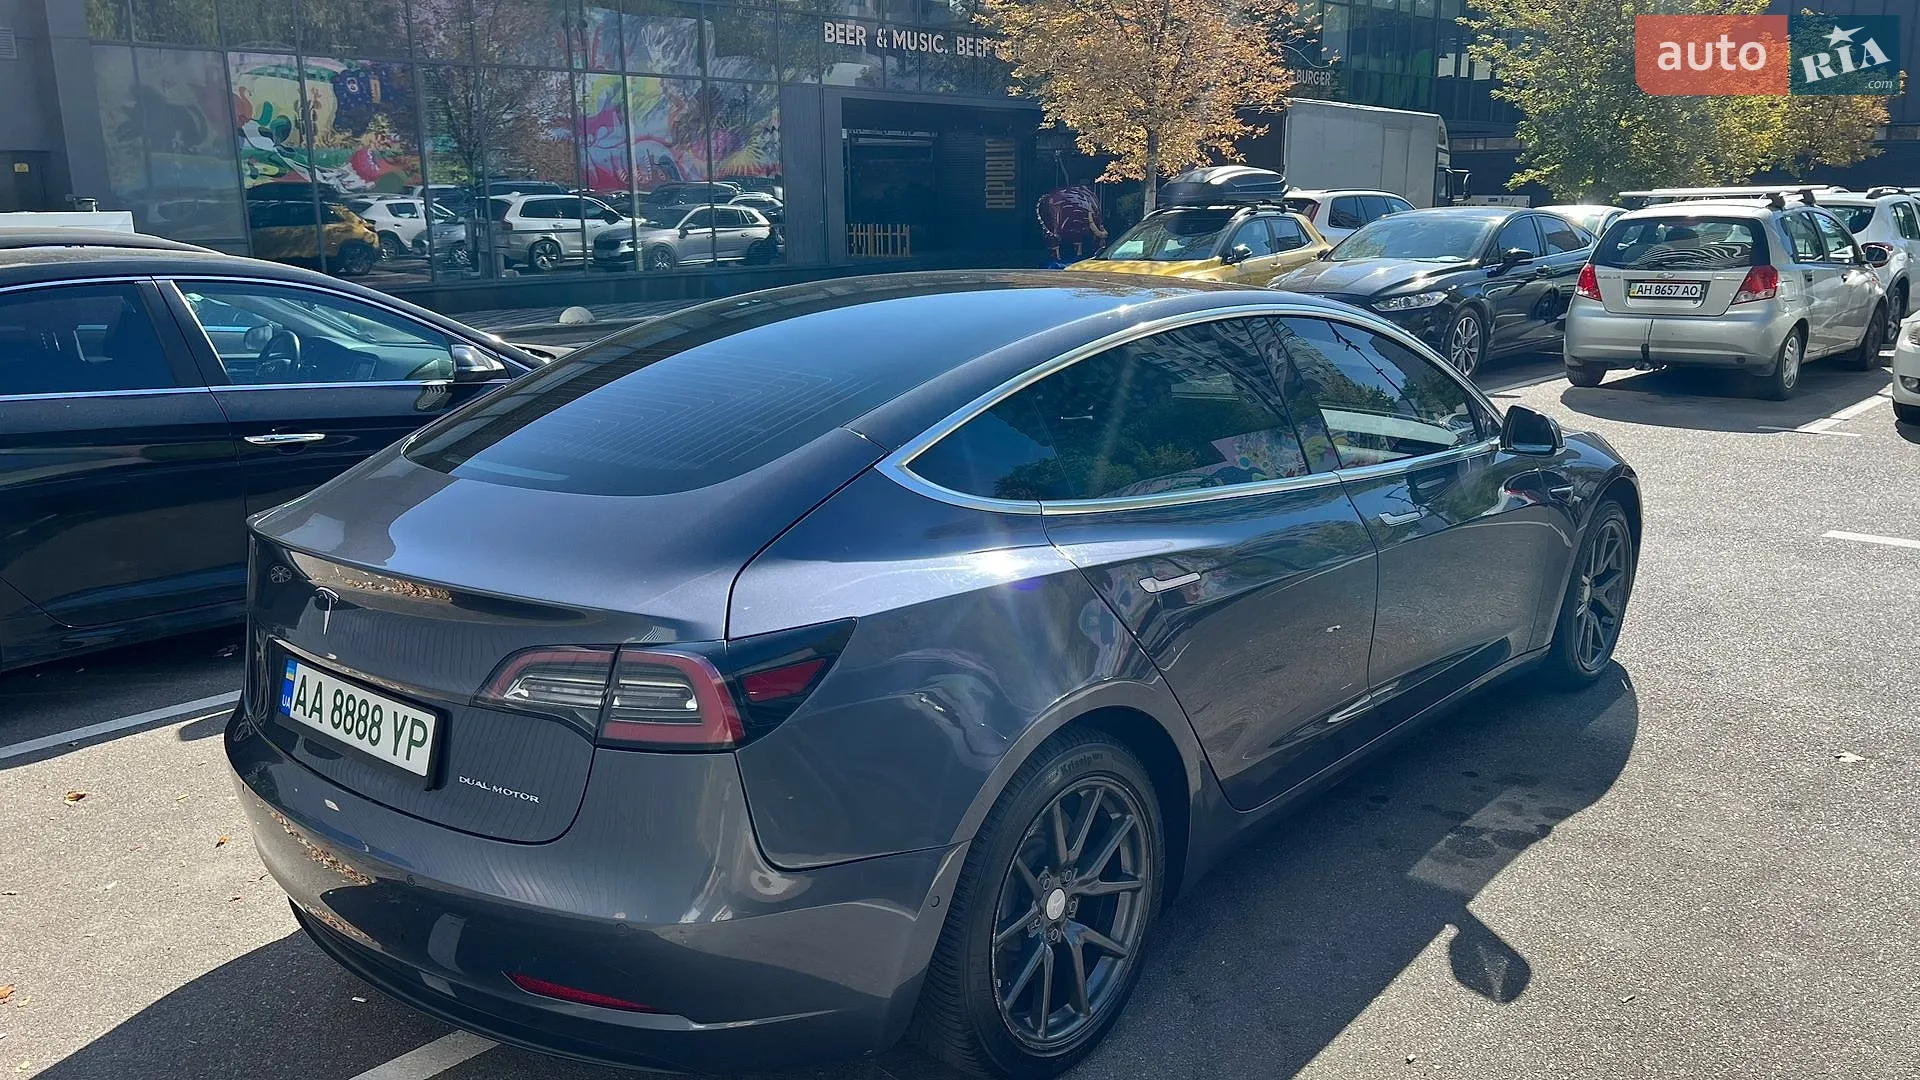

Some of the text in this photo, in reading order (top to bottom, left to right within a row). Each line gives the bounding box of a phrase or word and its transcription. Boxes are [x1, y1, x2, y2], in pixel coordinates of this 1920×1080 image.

[824, 22, 867, 47] BEER
[876, 28, 888, 48] &
[892, 30, 949, 54] MUSIC.
[1296, 68, 1331, 86] BURGER
[985, 138, 1016, 209] REPUBLIC
[1636, 284, 1698, 296] AH 8657 AO
[281, 694, 291, 709] UA
[293, 674, 428, 761] AA 8888 YP
[459, 776, 541, 804] DUAL MOTOR
